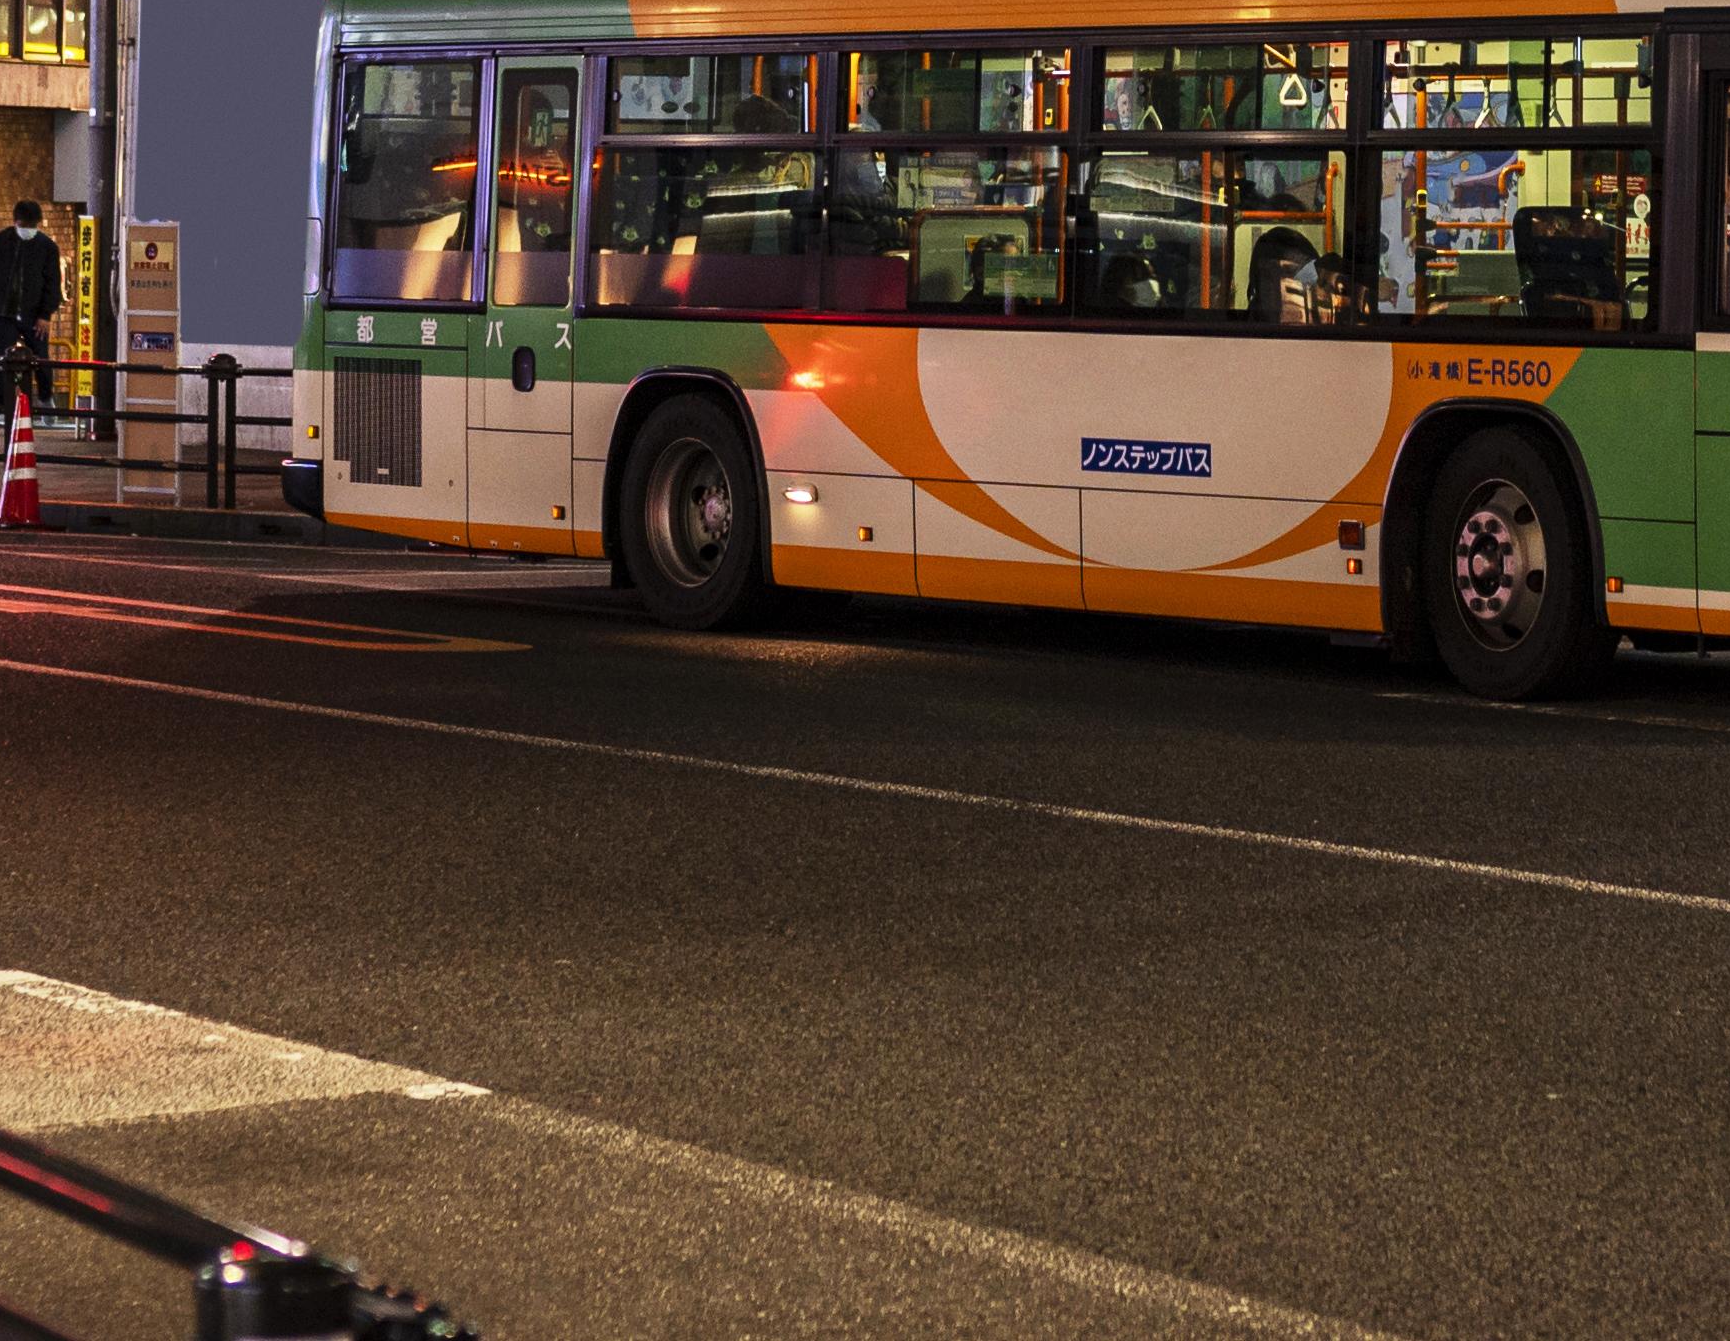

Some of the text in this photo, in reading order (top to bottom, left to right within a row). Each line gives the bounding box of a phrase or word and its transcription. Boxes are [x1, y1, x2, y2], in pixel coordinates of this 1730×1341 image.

[356, 315, 572, 351] 都営バス
[1468, 358, 1552, 387] E-R560
[1082, 442, 1211, 473] ノンステップバス
